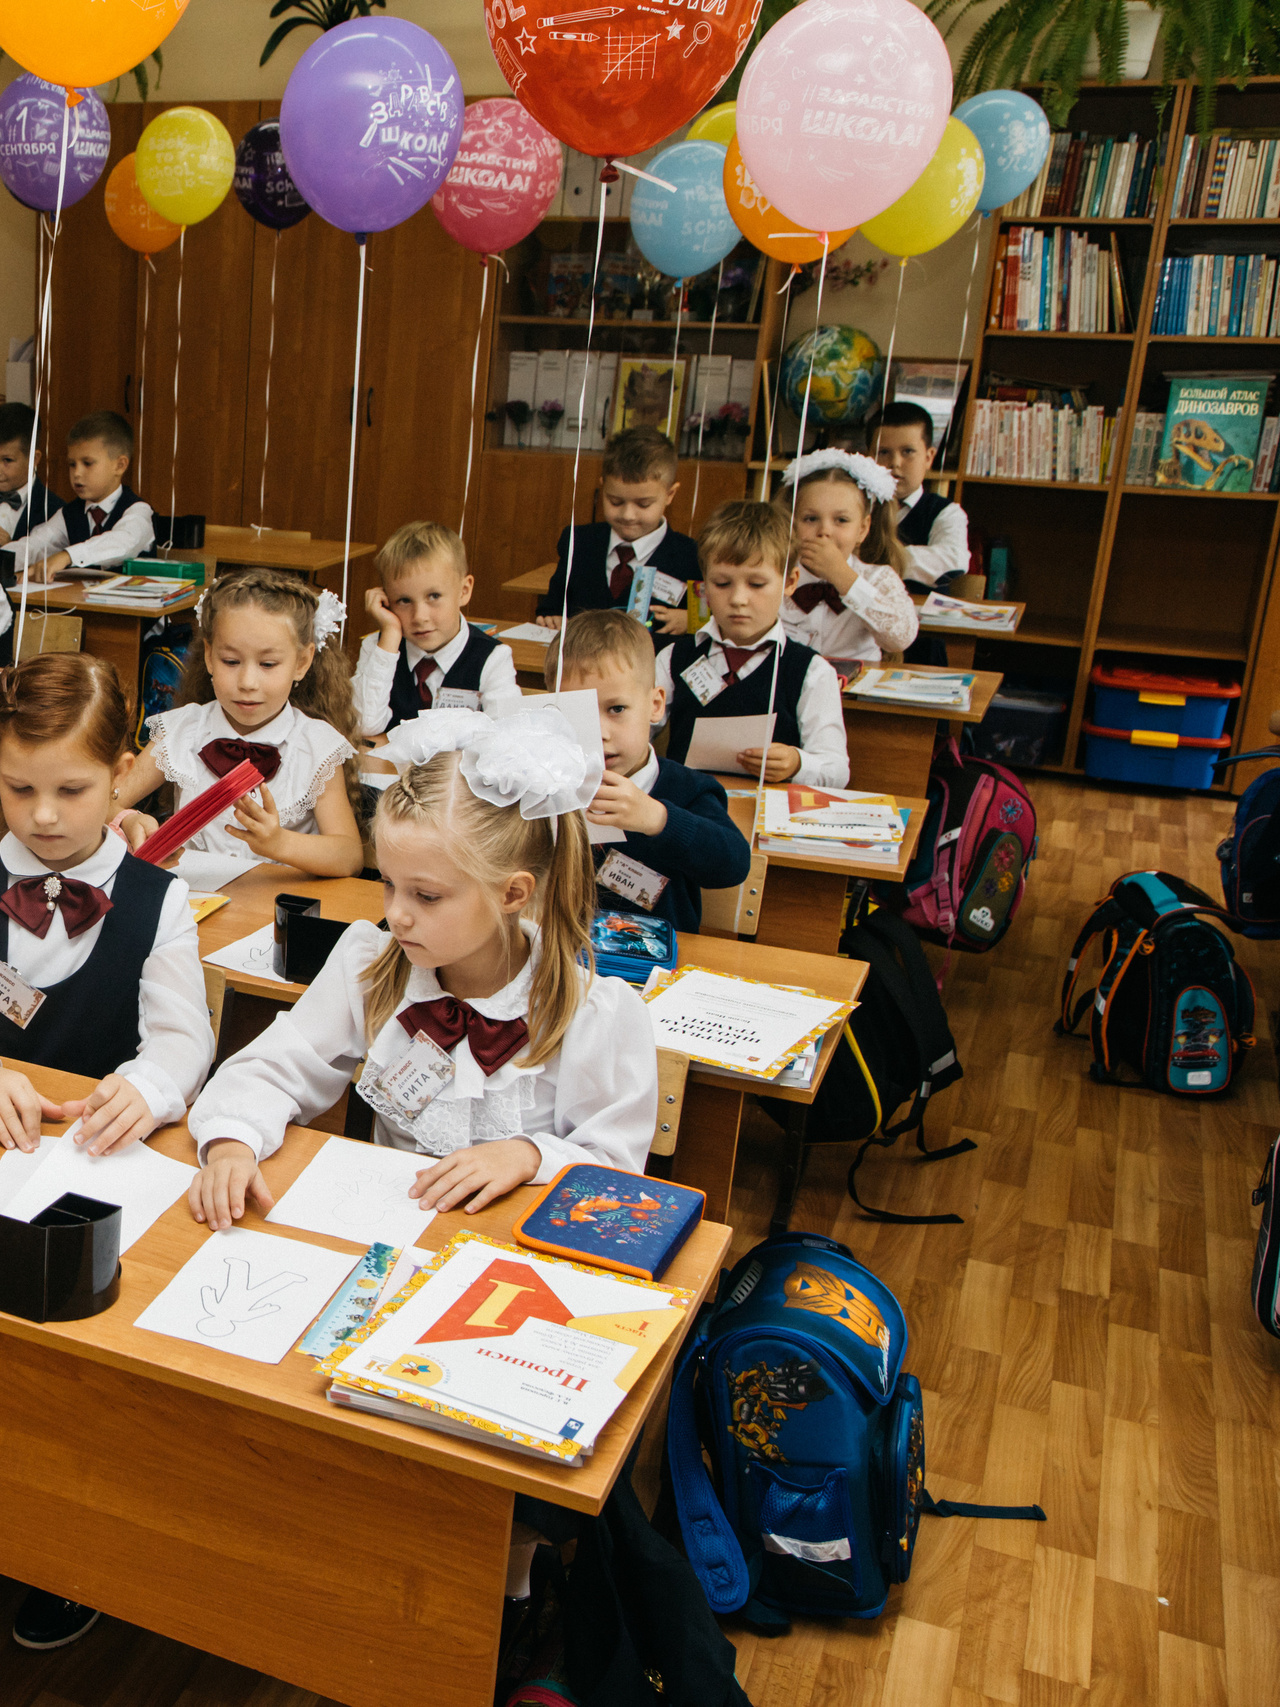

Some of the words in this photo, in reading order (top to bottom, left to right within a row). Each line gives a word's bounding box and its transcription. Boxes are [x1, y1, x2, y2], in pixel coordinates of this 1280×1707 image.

[379, 125, 449, 153] ШКОЛА
[0, 142, 56, 156] СЕНТЯБРЯ
[1180, 387, 1228, 399] БОЛЬШОЙ
[1229, 390, 1260, 401] АТЛАС
[1174, 400, 1260, 416] ДИНОЗАВРОВ
[609, 871, 635, 889] ИВАН
[397, 1058, 412, 1076] класс
[402, 1073, 430, 1101] РИТА
[464, 1278, 536, 1329] 1
[476, 1346, 592, 1392] Прописи
